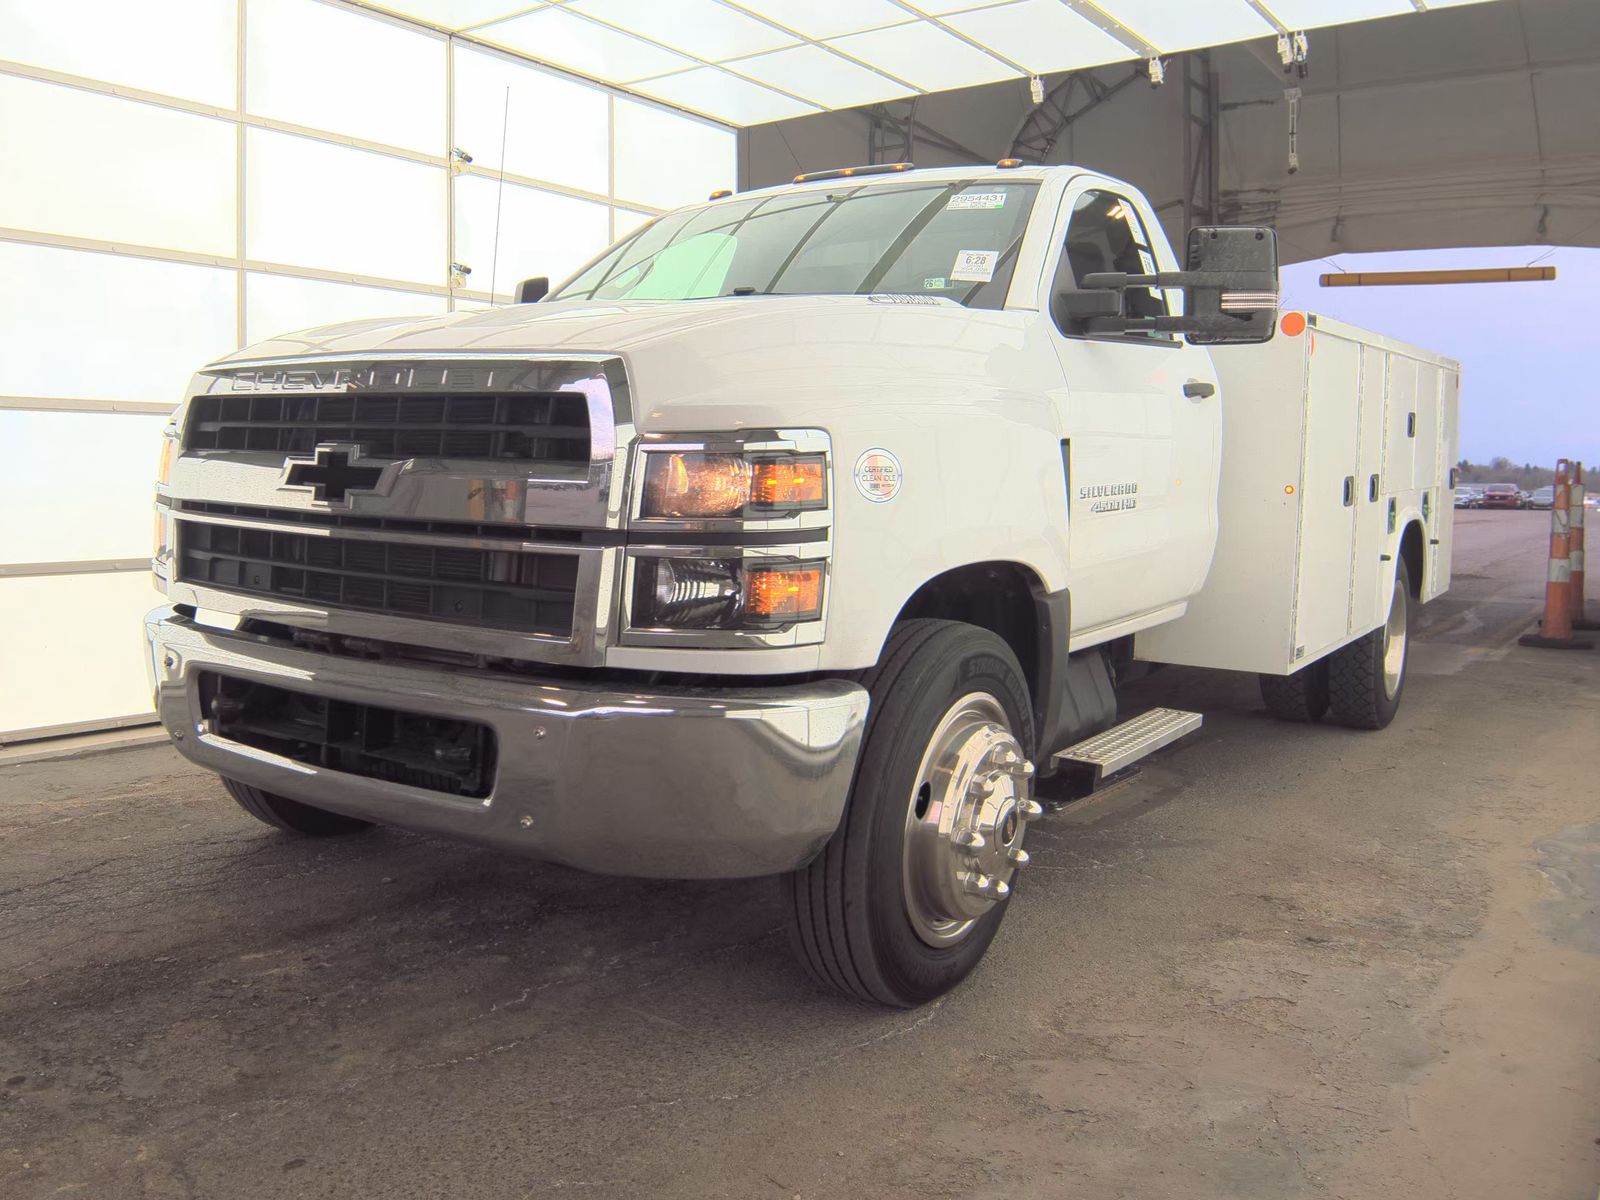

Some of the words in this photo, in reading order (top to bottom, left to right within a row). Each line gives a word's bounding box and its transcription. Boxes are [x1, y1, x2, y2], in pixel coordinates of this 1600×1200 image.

[952, 194, 1004, 202] 2954431
[965, 255, 987, 265] 6:28
[864, 465, 894, 473] CERTIFIED
[862, 474, 882, 482] CLEAN
[1079, 482, 1138, 499] SILVERADO
